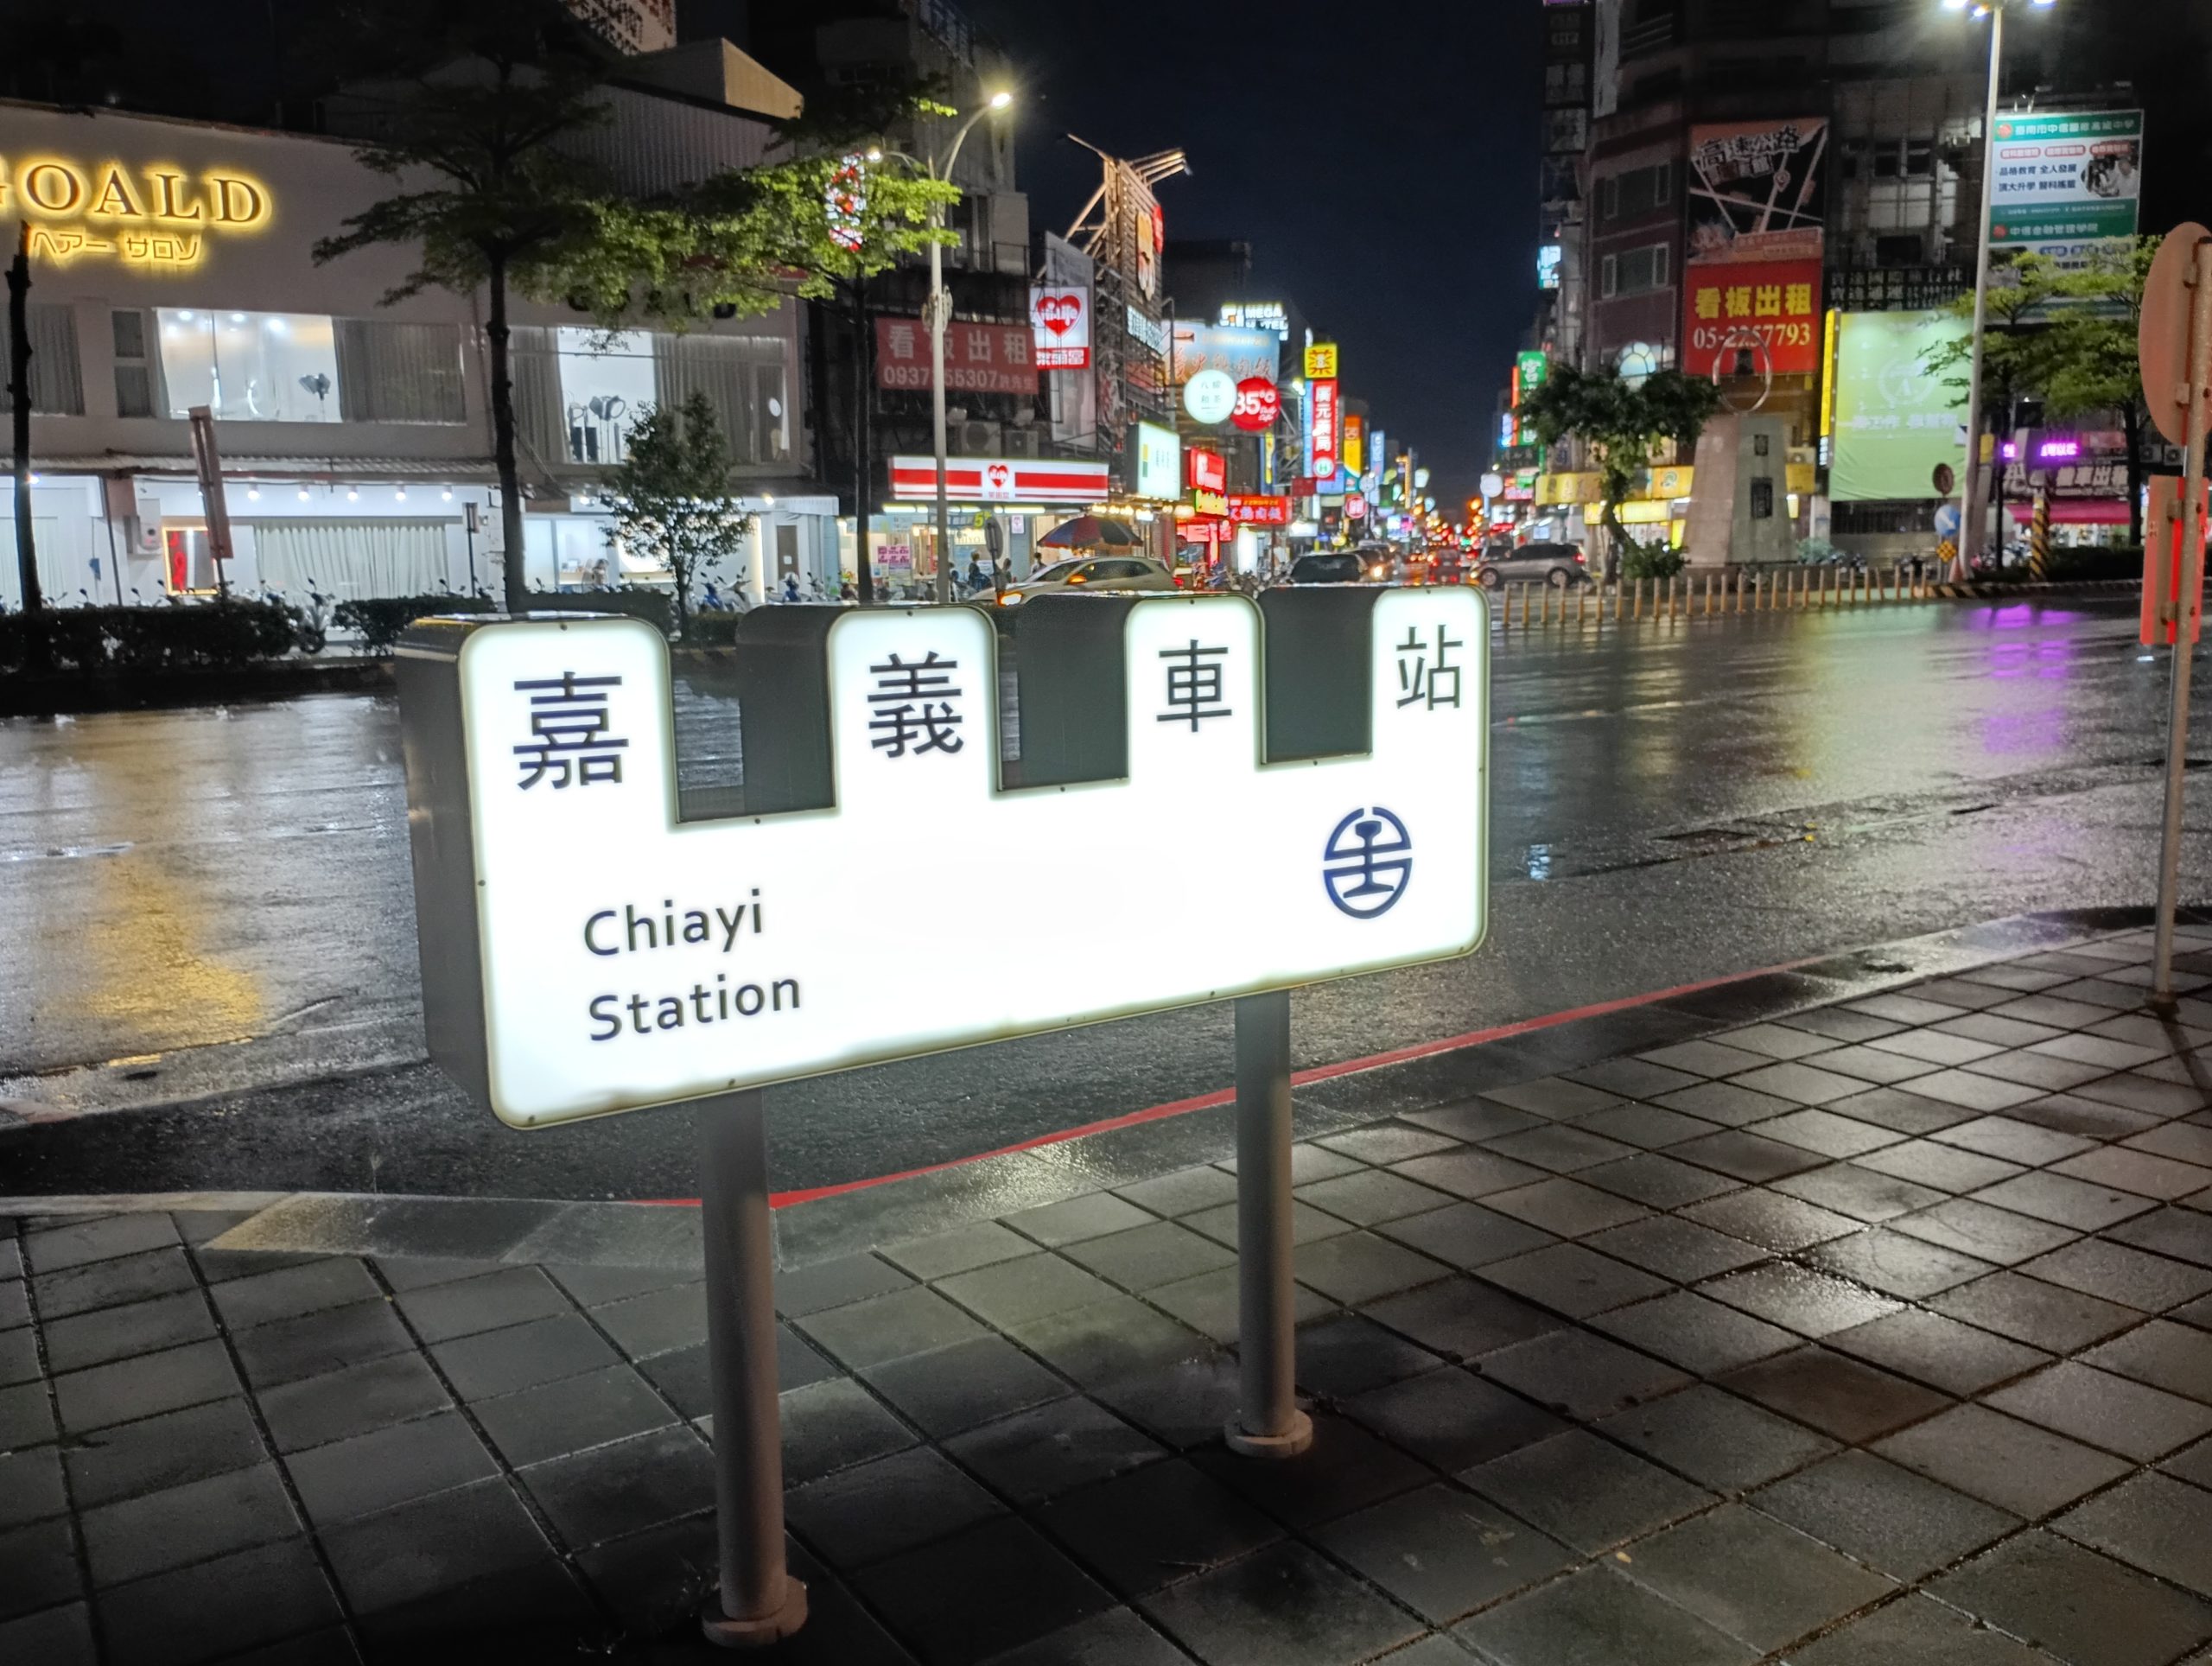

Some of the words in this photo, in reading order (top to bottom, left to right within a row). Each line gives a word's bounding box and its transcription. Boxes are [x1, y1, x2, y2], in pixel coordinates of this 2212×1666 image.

[0, 163, 263, 223] OALD
[33, 231, 108, 253] ヘアー
[1245, 304, 1283, 319] MEGA
[1694, 283, 1813, 320] 看板出租
[513, 624, 1463, 792] 嘉義車站
[584, 887, 762, 957] Chiayi
[588, 973, 800, 1042] Station
